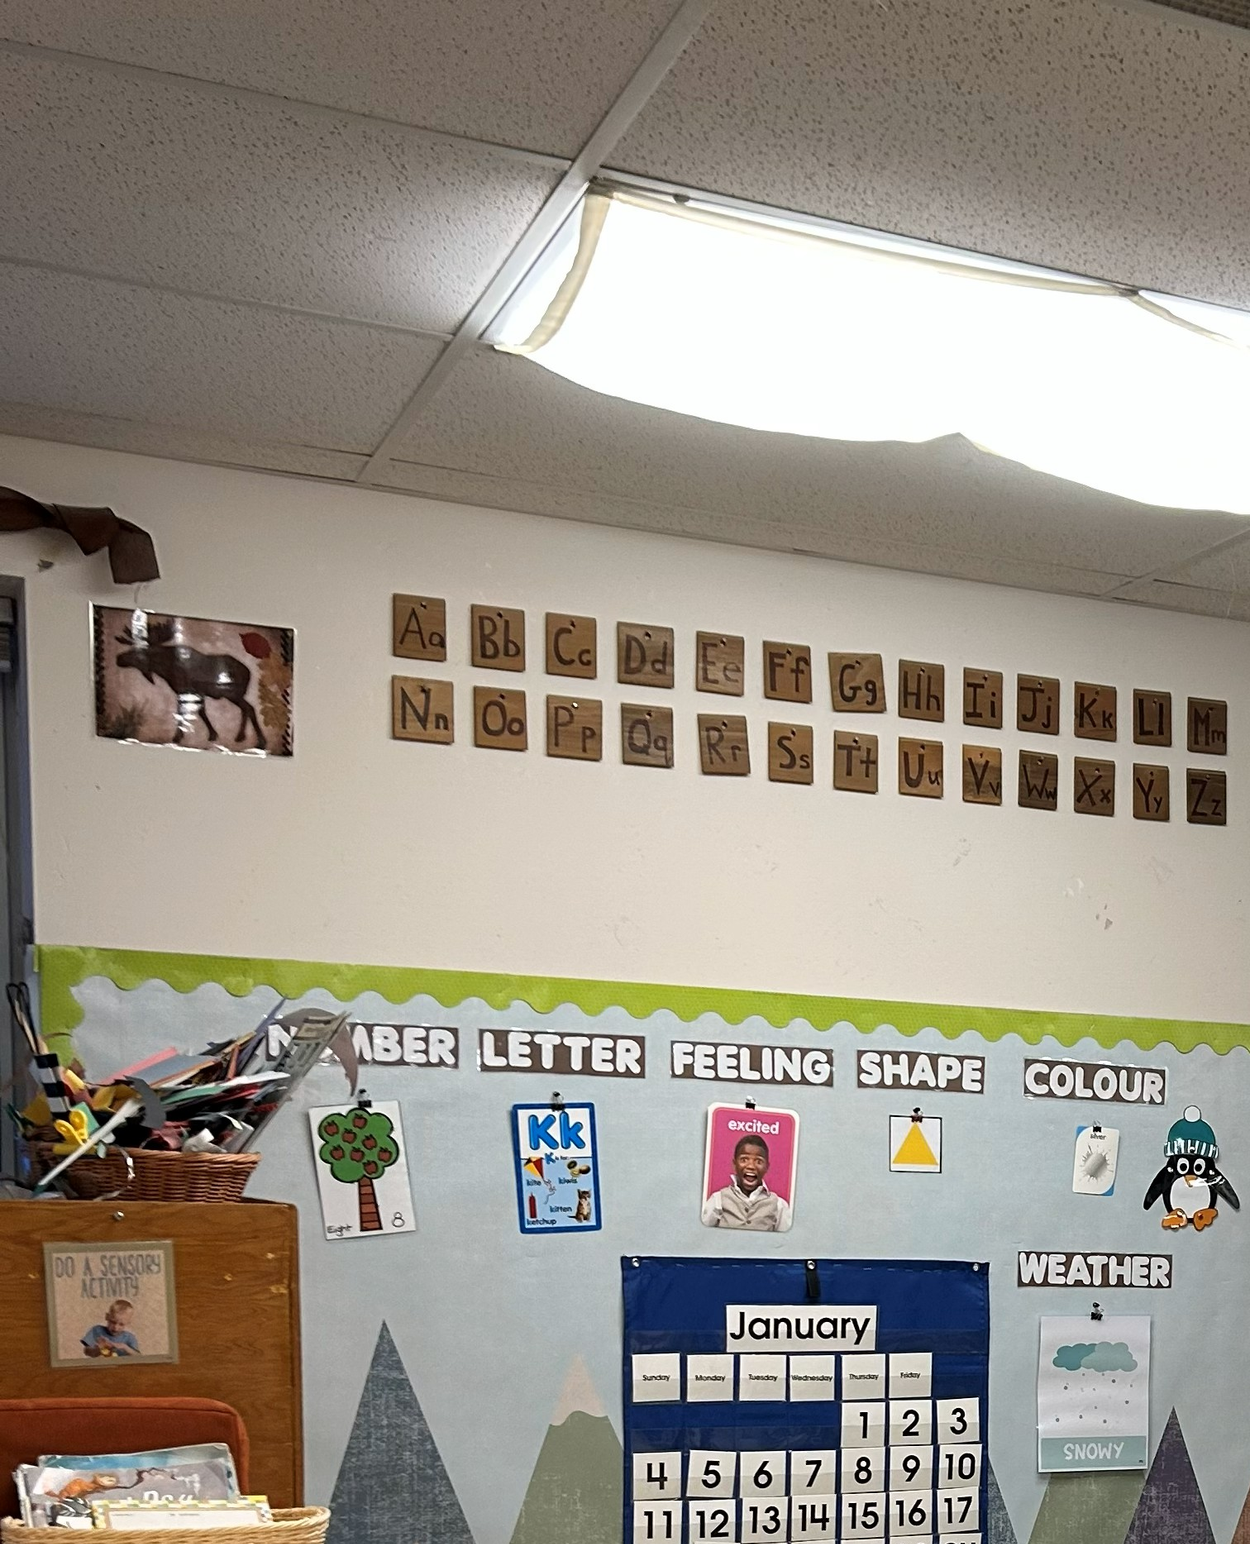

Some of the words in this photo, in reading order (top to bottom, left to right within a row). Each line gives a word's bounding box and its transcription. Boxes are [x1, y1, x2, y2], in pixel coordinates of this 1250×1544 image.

[400, 608, 445, 650] Aa
[478, 615, 520, 659] Bb
[553, 627, 591, 667] Cc
[624, 634, 667, 675] Dd
[701, 642, 741, 685] Ee
[769, 652, 809, 693] Ff
[838, 664, 877, 706] Gg
[903, 671, 941, 712] Hh
[966, 682, 997, 720] Ii
[1020, 685, 1052, 730] Jj
[1078, 697, 1114, 730] Kk
[1138, 698, 1164, 736] Ll
[1194, 708, 1226, 746] Mm
[401, 687, 448, 732] Nn
[482, 700, 525, 737] Oo
[553, 705, 596, 753] Pp
[627, 719, 673, 767] Qq
[705, 726, 741, 764] Rr
[778, 735, 810, 770] Ss
[837, 744, 877, 778] Tt
[905, 754, 940, 788] Uu
[967, 757, 1000, 797] Vv
[1023, 764, 1056, 801] Ww
[1077, 769, 1111, 807] Xx
[1137, 775, 1163, 814] Yy
[1191, 778, 1222, 818] Zz
[482, 1030, 643, 1075] LETTER
[673, 1042, 830, 1084] FEELING
[859, 1051, 983, 1092] SHAPE
[1026, 1064, 1164, 1103] COLOUR
[528, 1111, 586, 1150] Kk
[728, 1119, 780, 1136] excited
[392, 1211, 405, 1228] 8
[526, 1218, 557, 1226] ketchup
[549, 1205, 572, 1213] kitten
[55, 1256, 75, 1278] DO
[82, 1256, 92, 1277] A
[100, 1253, 160, 1276] SENSORY
[1019, 1252, 1171, 1287] WEATHER
[81, 1277, 139, 1299] ACTIVITY
[730, 1311, 871, 1345] January
[642, 1374, 670, 1382] Sunday
[695, 1374, 726, 1382] Monday
[748, 1373, 778, 1381] Tuesday
[791, 1374, 833, 1382] Wednesday
[849, 1373, 879, 1381] Thursday
[900, 1371, 921, 1379] Friday
[859, 1411, 869, 1439] 1
[902, 1409, 920, 1437] 2
[950, 1408, 968, 1435] 3
[1063, 1442, 1124, 1461] SNOWY
[647, 1462, 668, 1490] 4
[701, 1461, 721, 1489] 5
[753, 1461, 773, 1489] 6
[804, 1459, 822, 1488] 7
[854, 1457, 872, 1484] 8
[902, 1454, 920, 1482] 9
[946, 1452, 976, 1480] 10
[643, 1511, 674, 1539] 11
[696, 1509, 730, 1538] 12
[749, 1505, 781, 1534] 13
[799, 1503, 830, 1532] 14
[849, 1501, 879, 1529] 15
[896, 1499, 927, 1527] 16
[944, 1496, 973, 1524] 17
